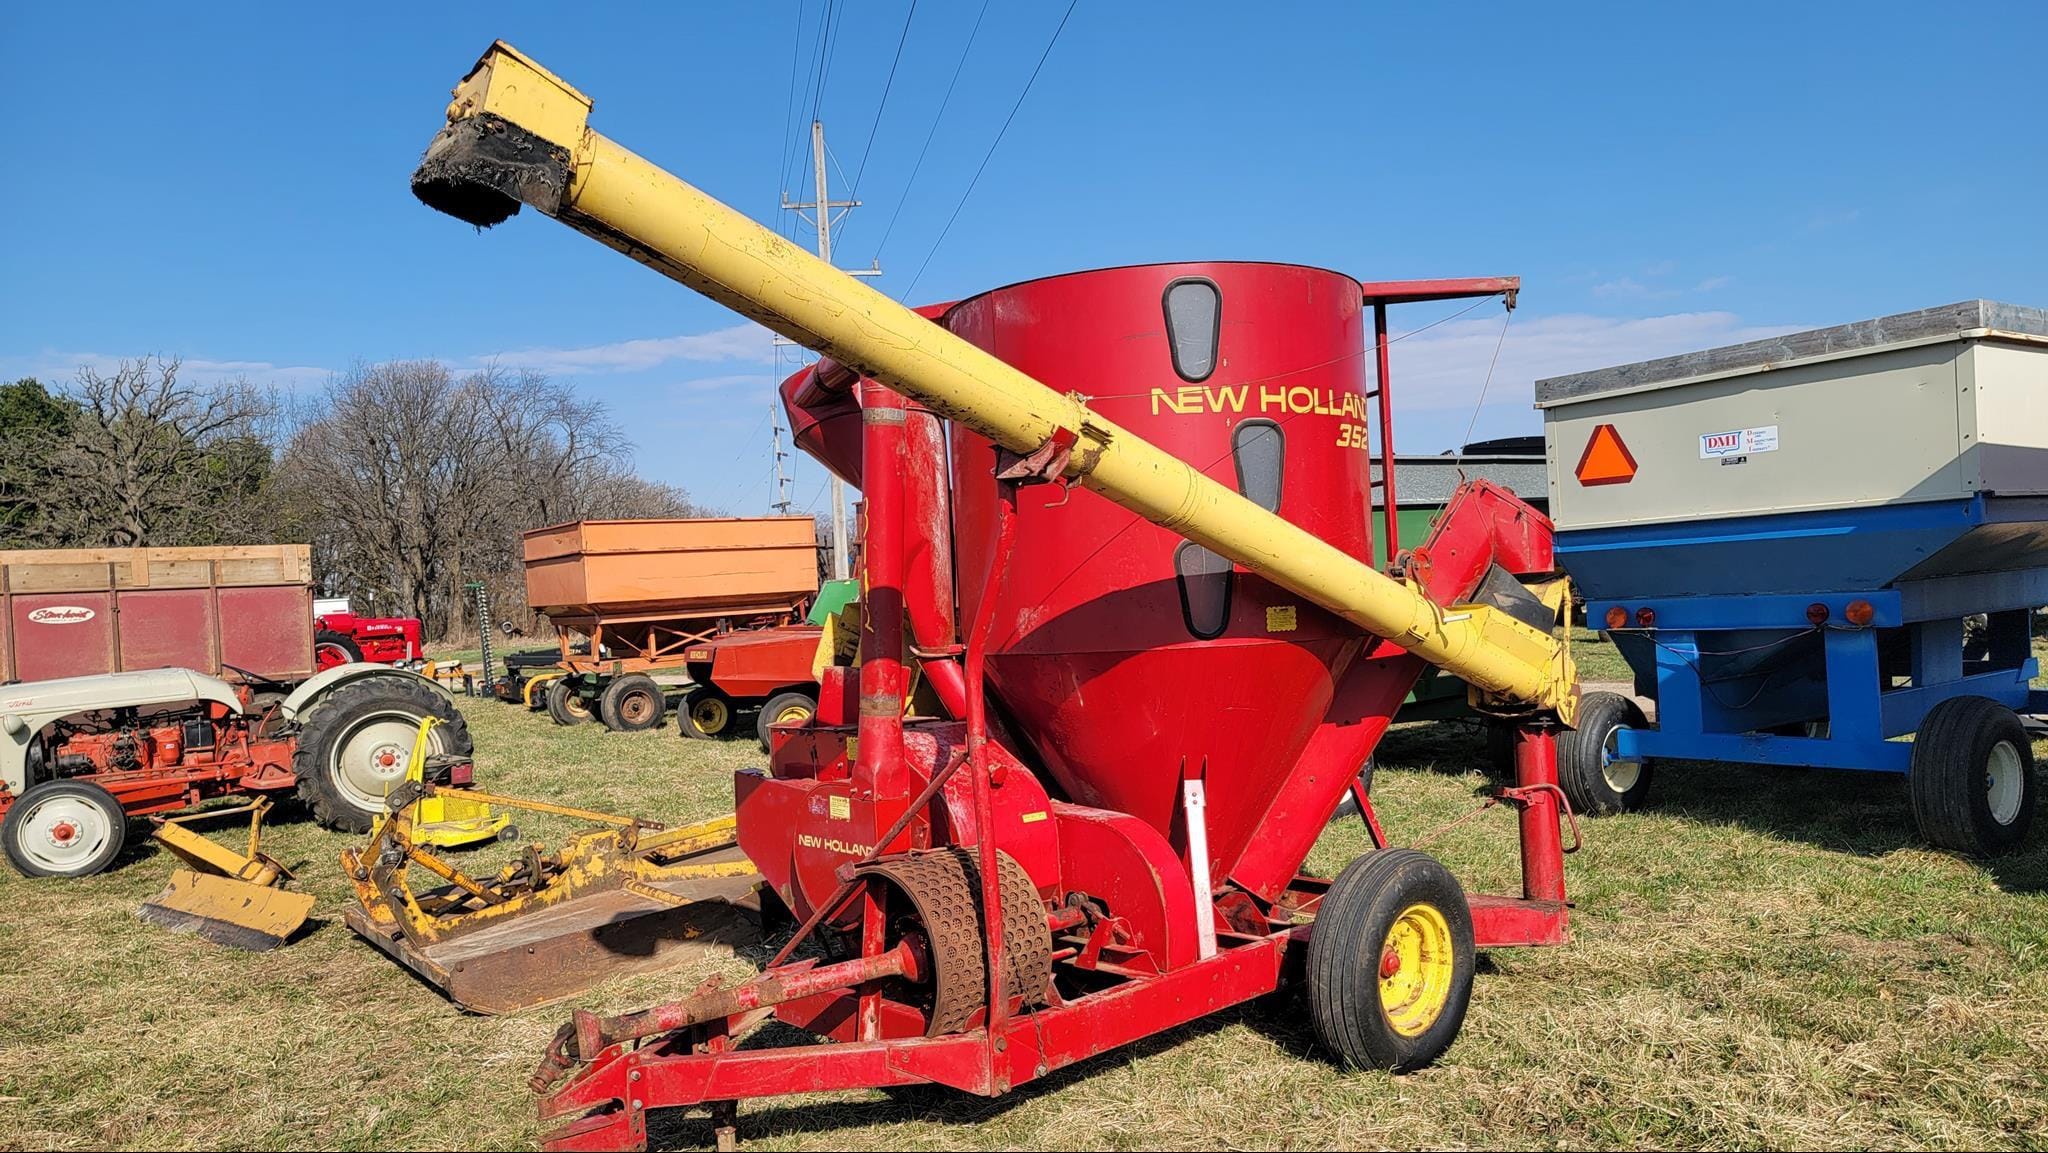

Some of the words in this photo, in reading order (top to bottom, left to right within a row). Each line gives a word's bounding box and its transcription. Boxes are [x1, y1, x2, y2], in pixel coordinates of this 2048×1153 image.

[1151, 385, 1248, 416] NEW
[1336, 423, 1367, 450] 352
[1708, 434, 1737, 449] DMI
[798, 834, 821, 849] NEW
